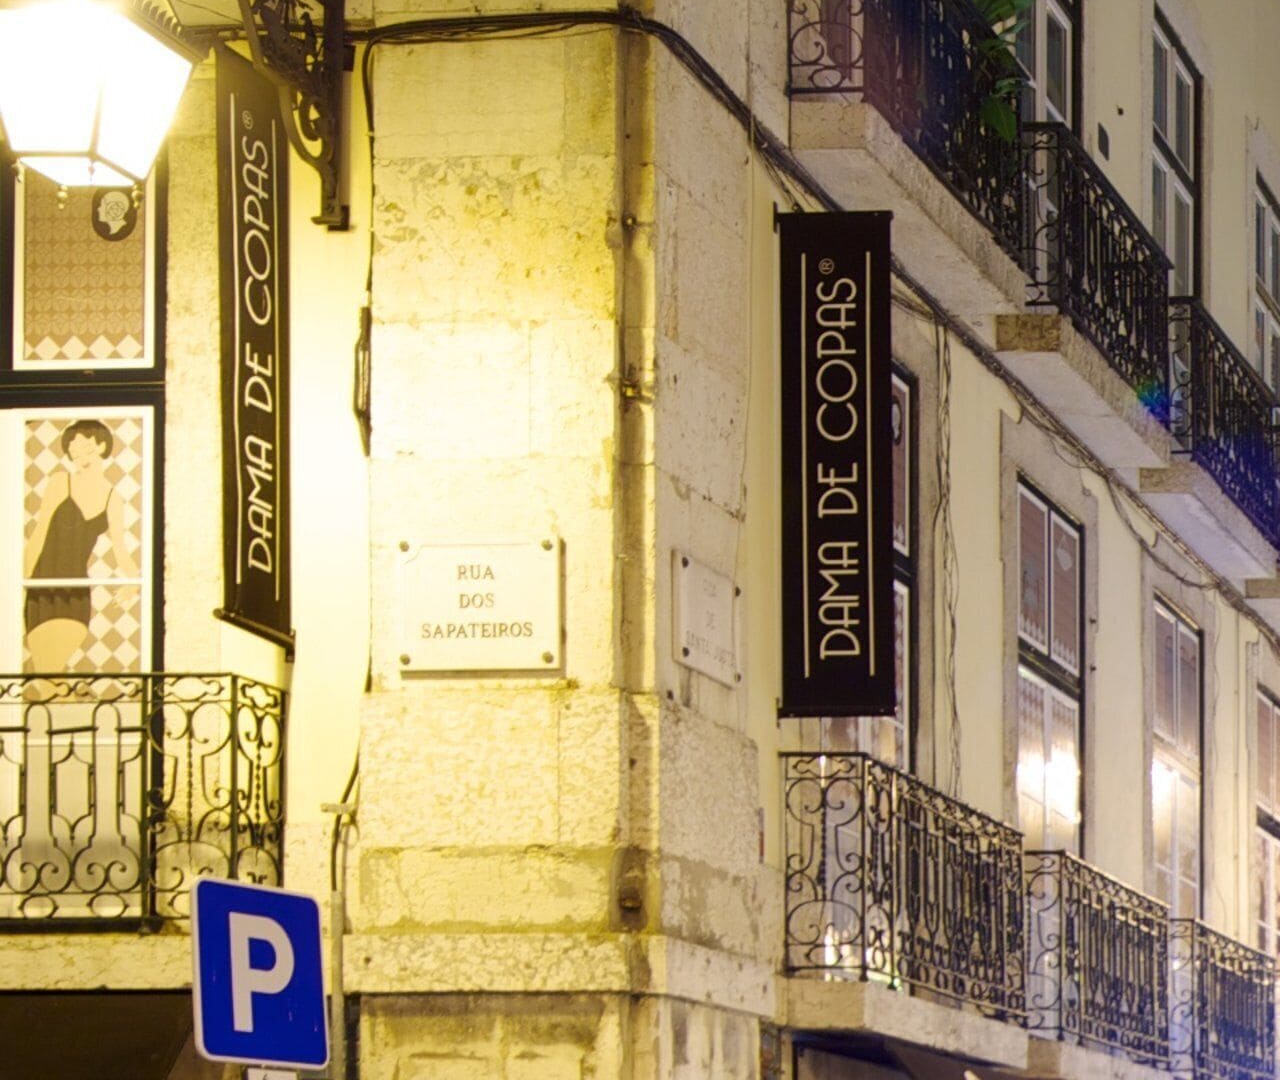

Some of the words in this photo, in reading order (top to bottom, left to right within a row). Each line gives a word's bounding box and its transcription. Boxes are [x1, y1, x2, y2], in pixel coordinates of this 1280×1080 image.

[242, 135, 271, 325] COPAS
[244, 341, 273, 413] DE
[816, 277, 858, 441] COPAS
[243, 434, 273, 574] DAMA
[817, 462, 858, 518] DE
[457, 564, 495, 580] RUA
[459, 593, 495, 609] DOS
[817, 541, 861, 660] DAMA
[421, 622, 534, 639] SAPATEIROS
[228, 911, 295, 1033] P
